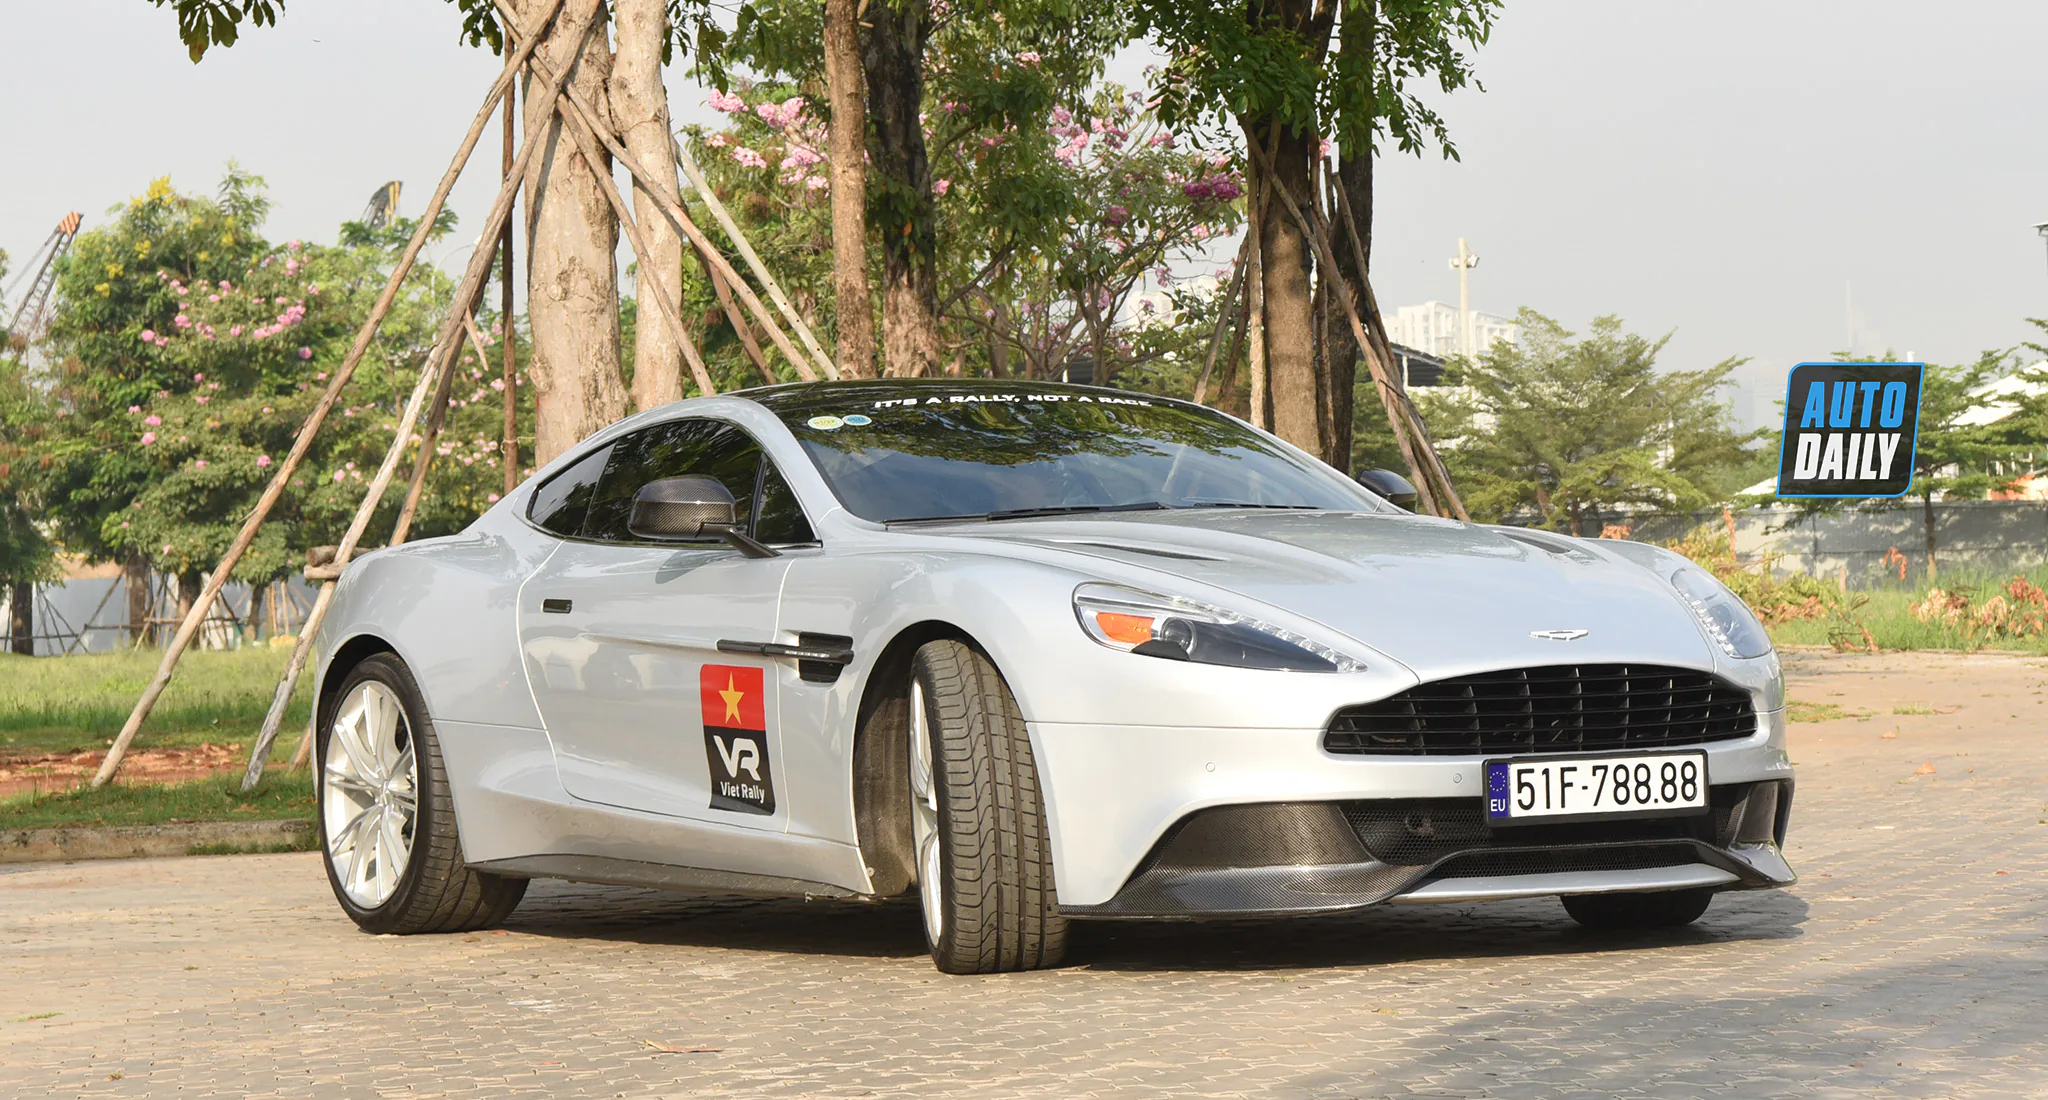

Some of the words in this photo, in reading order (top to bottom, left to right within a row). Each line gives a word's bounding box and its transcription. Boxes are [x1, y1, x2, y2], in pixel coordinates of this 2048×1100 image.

[874, 398, 918, 408] IT'S
[925, 396, 942, 405] A
[949, 394, 1020, 403] RALLY,
[1027, 394, 1071, 402] NOT
[1078, 395, 1093, 403] A
[1097, 396, 1153, 407] RACE
[713, 735, 761, 781] VR
[720, 781, 740, 797] Viet
[741, 783, 765, 804] Rally
[1516, 760, 1698, 811] 51F-788.88
[1490, 798, 1506, 812] EU
